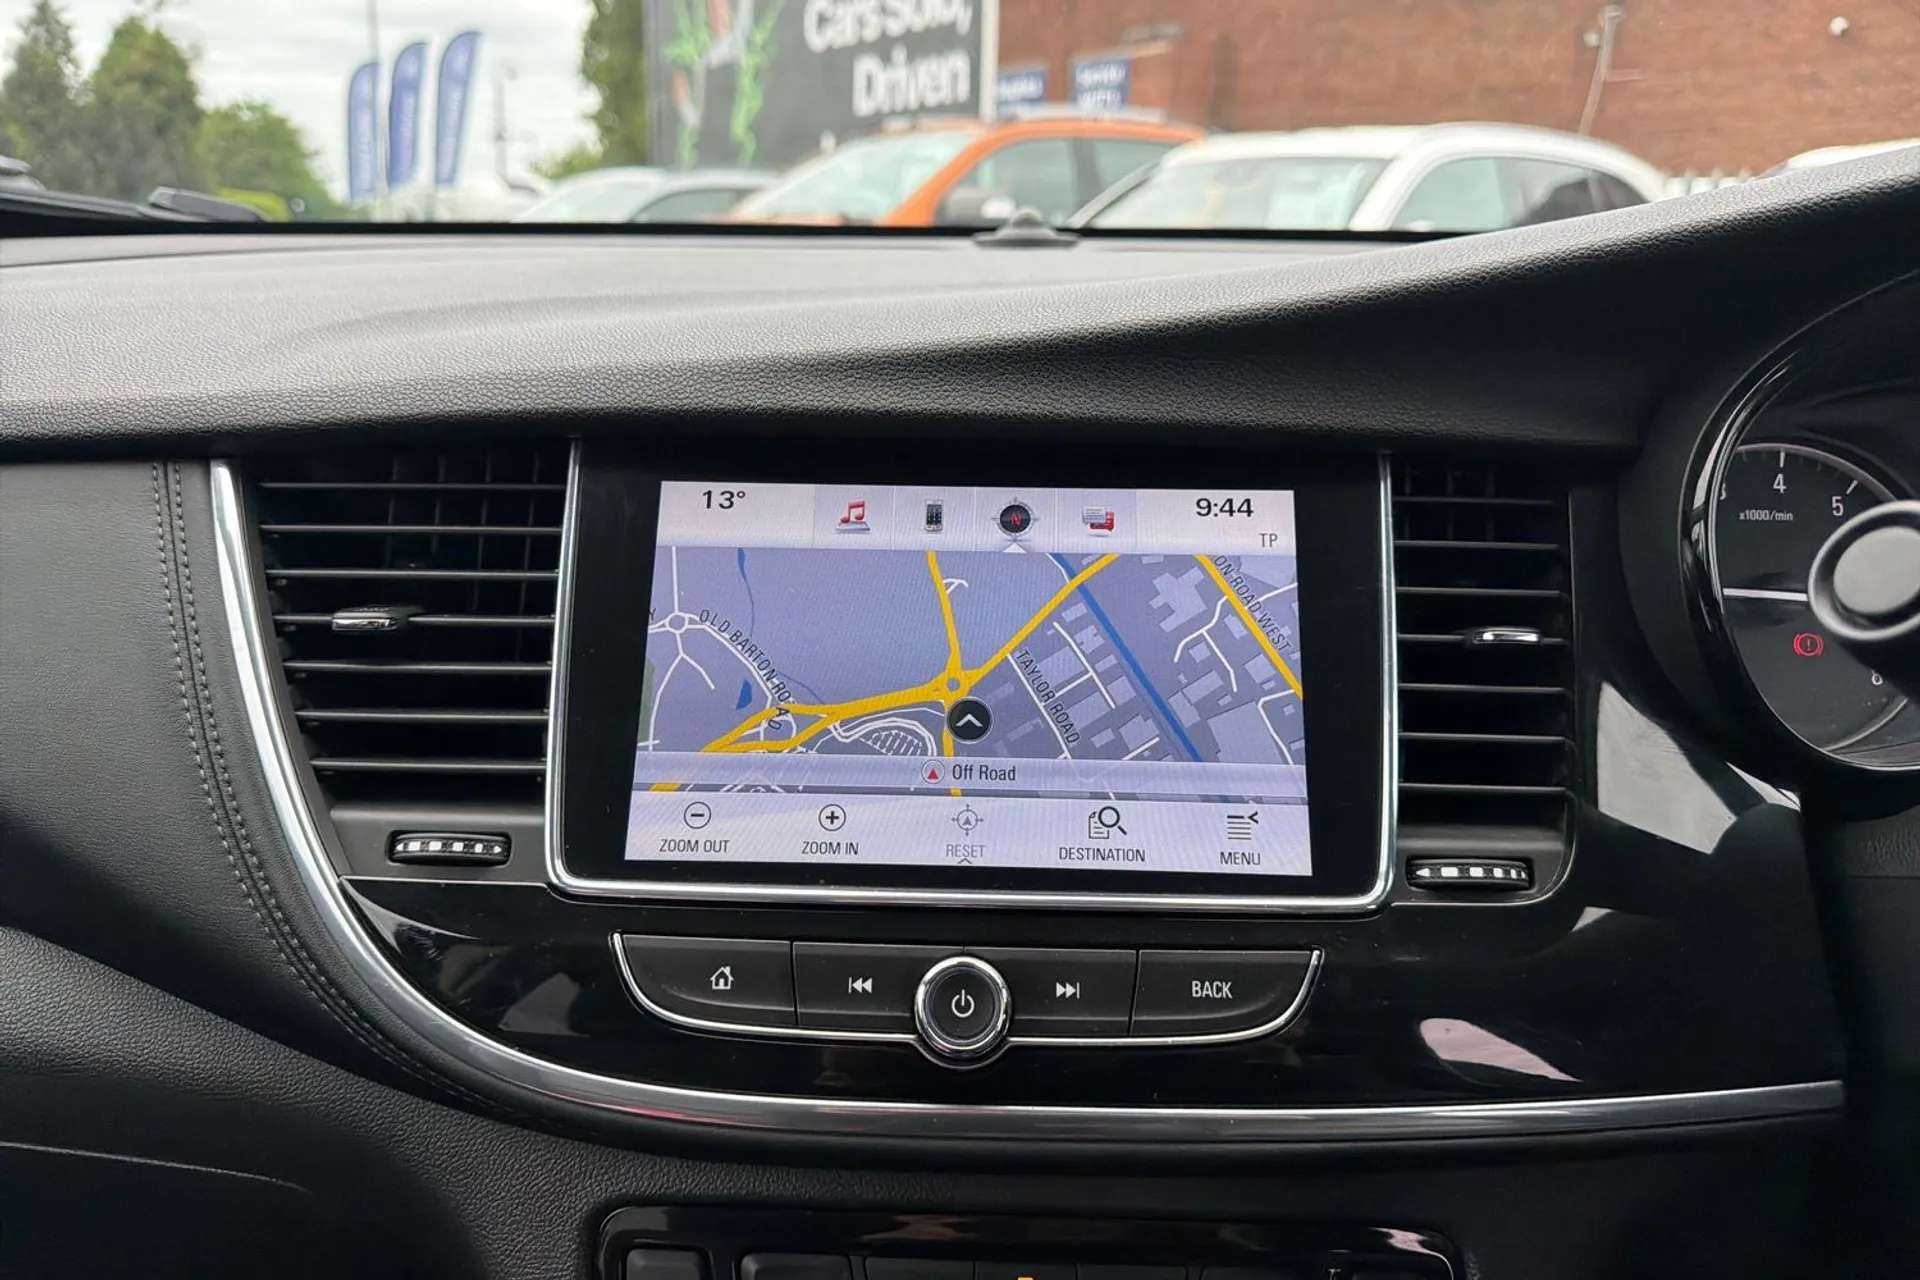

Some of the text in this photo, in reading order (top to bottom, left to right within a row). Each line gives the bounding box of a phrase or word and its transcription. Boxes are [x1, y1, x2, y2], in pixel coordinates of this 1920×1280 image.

[852, 43, 971, 117] Driven
[1772, 473, 1787, 494] 4
[702, 489, 746, 509] 13°
[1195, 498, 1254, 517] 9:44
[1831, 496, 1844, 516] 5
[1739, 509, 1794, 521] x1000/min
[1259, 533, 1278, 548] TP
[1230, 575, 1262, 614] ROAD
[1257, 612, 1292, 652] WEST
[699, 608, 792, 731] OLD BARTON ROAD
[1016, 649, 1081, 745] TAYLOR ROAD
[952, 764, 1016, 781] Off Road
[659, 839, 731, 853] ZOOM OUT
[801, 841, 859, 855] ZOOM IN
[945, 843, 987, 858] RESET
[1058, 847, 1146, 862] DESTINATION
[1219, 851, 1261, 865] MENU
[1191, 980, 1233, 999] BACK
